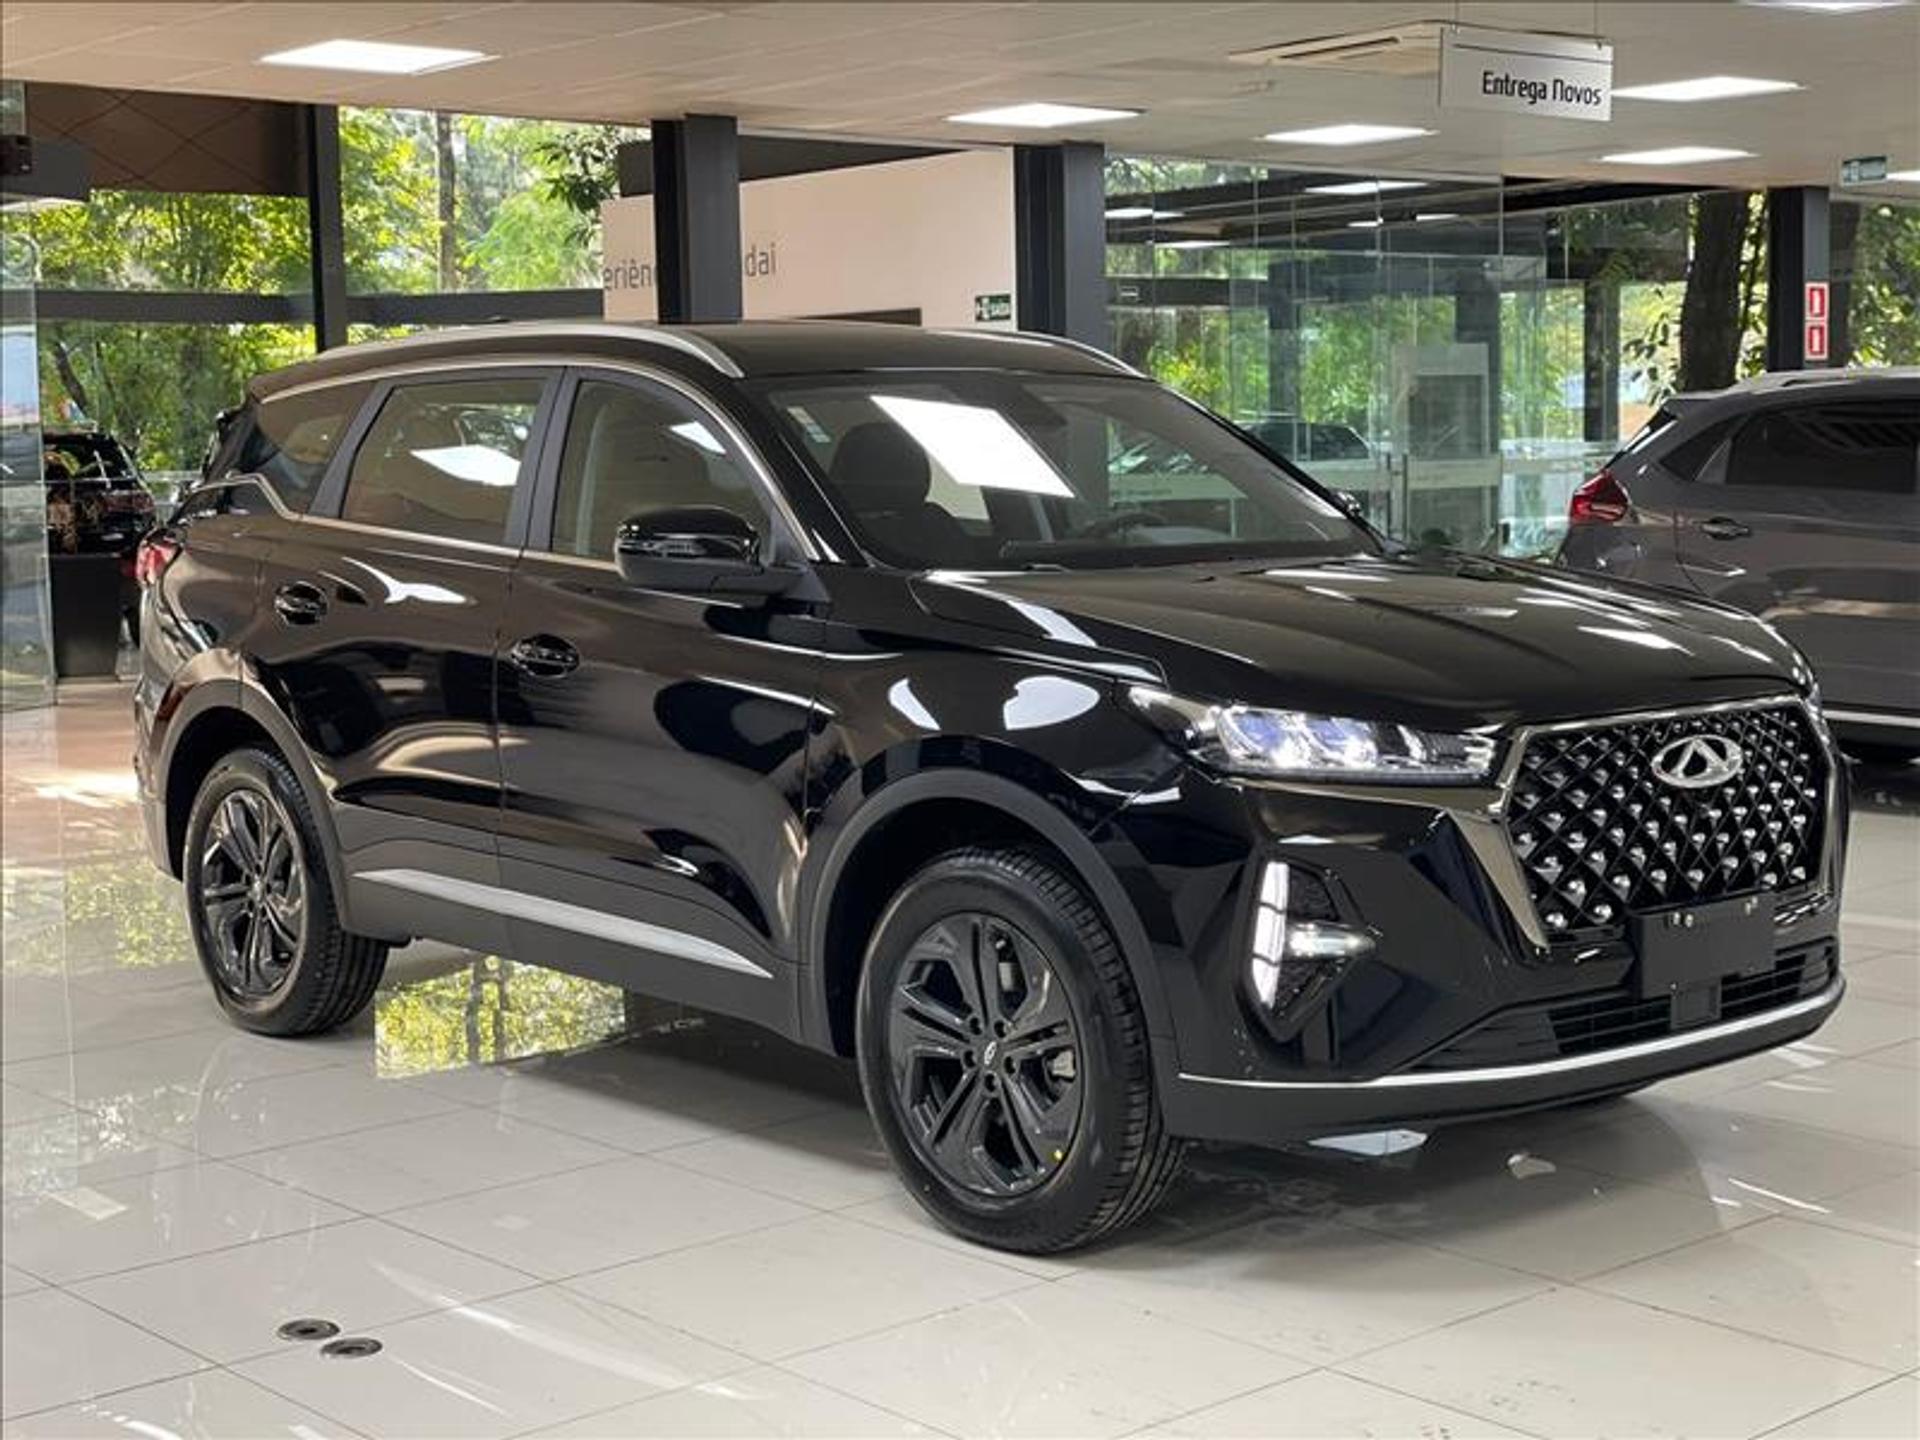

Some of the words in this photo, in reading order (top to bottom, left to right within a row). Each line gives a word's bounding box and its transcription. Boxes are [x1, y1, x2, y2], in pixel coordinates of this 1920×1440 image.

[1482, 70, 1547, 104] Entrega
[1552, 78, 1602, 105] Novos
[602, 258, 657, 291] eriên
